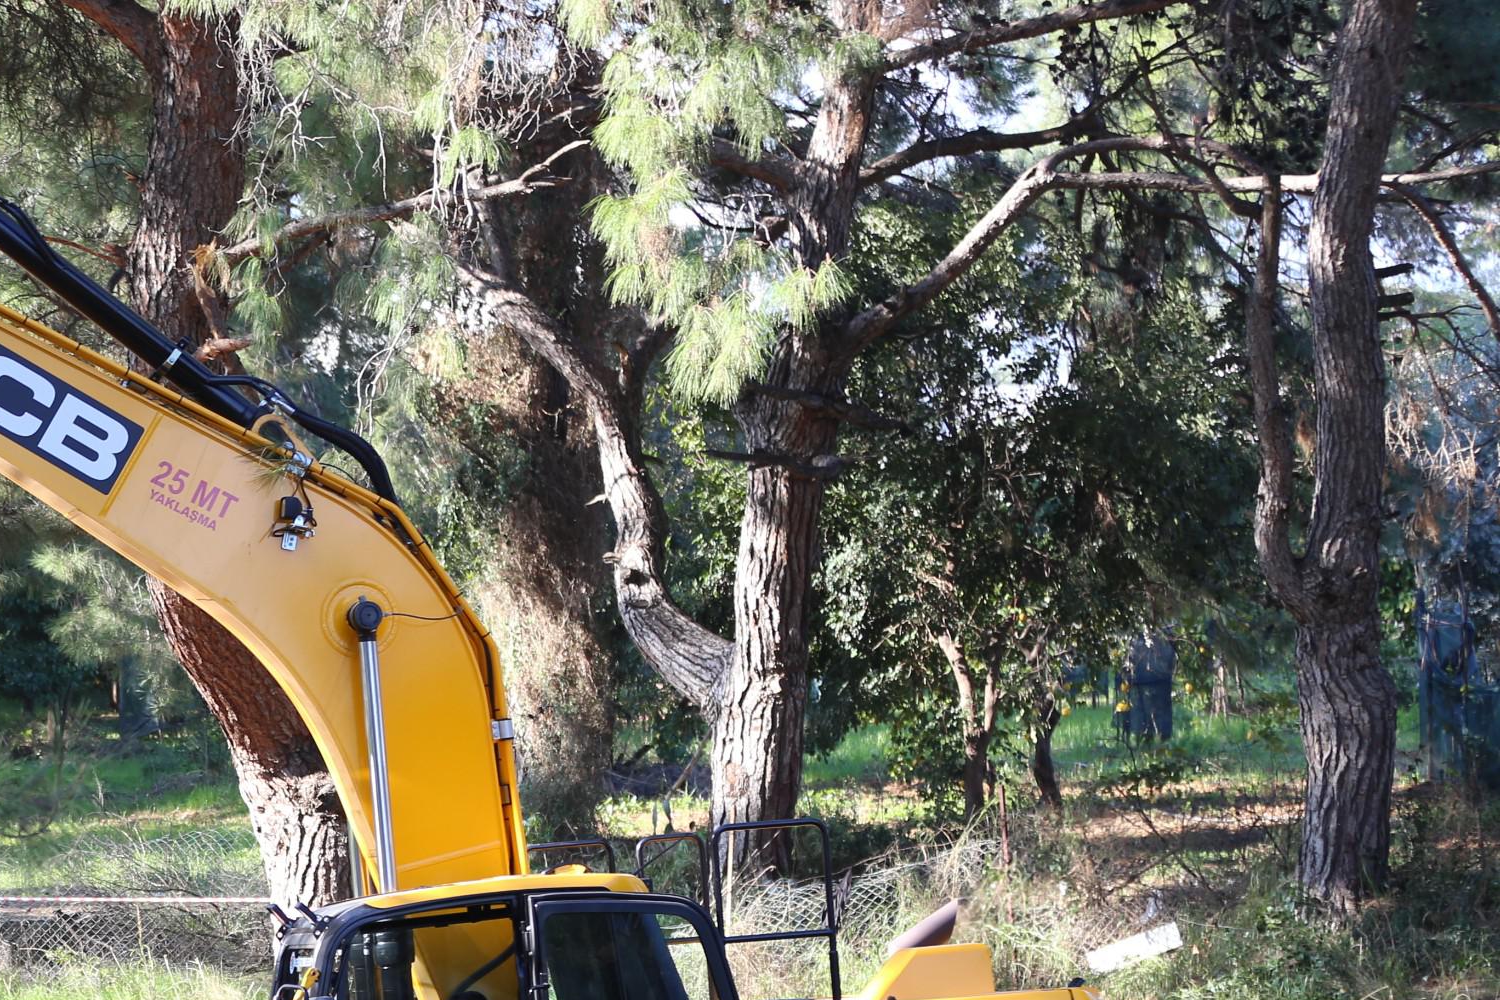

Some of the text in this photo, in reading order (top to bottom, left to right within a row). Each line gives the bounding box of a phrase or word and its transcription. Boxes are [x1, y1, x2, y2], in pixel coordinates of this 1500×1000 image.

[150, 461, 239, 518] 25 MT
[150, 488, 217, 531] YAKLAŞMA
